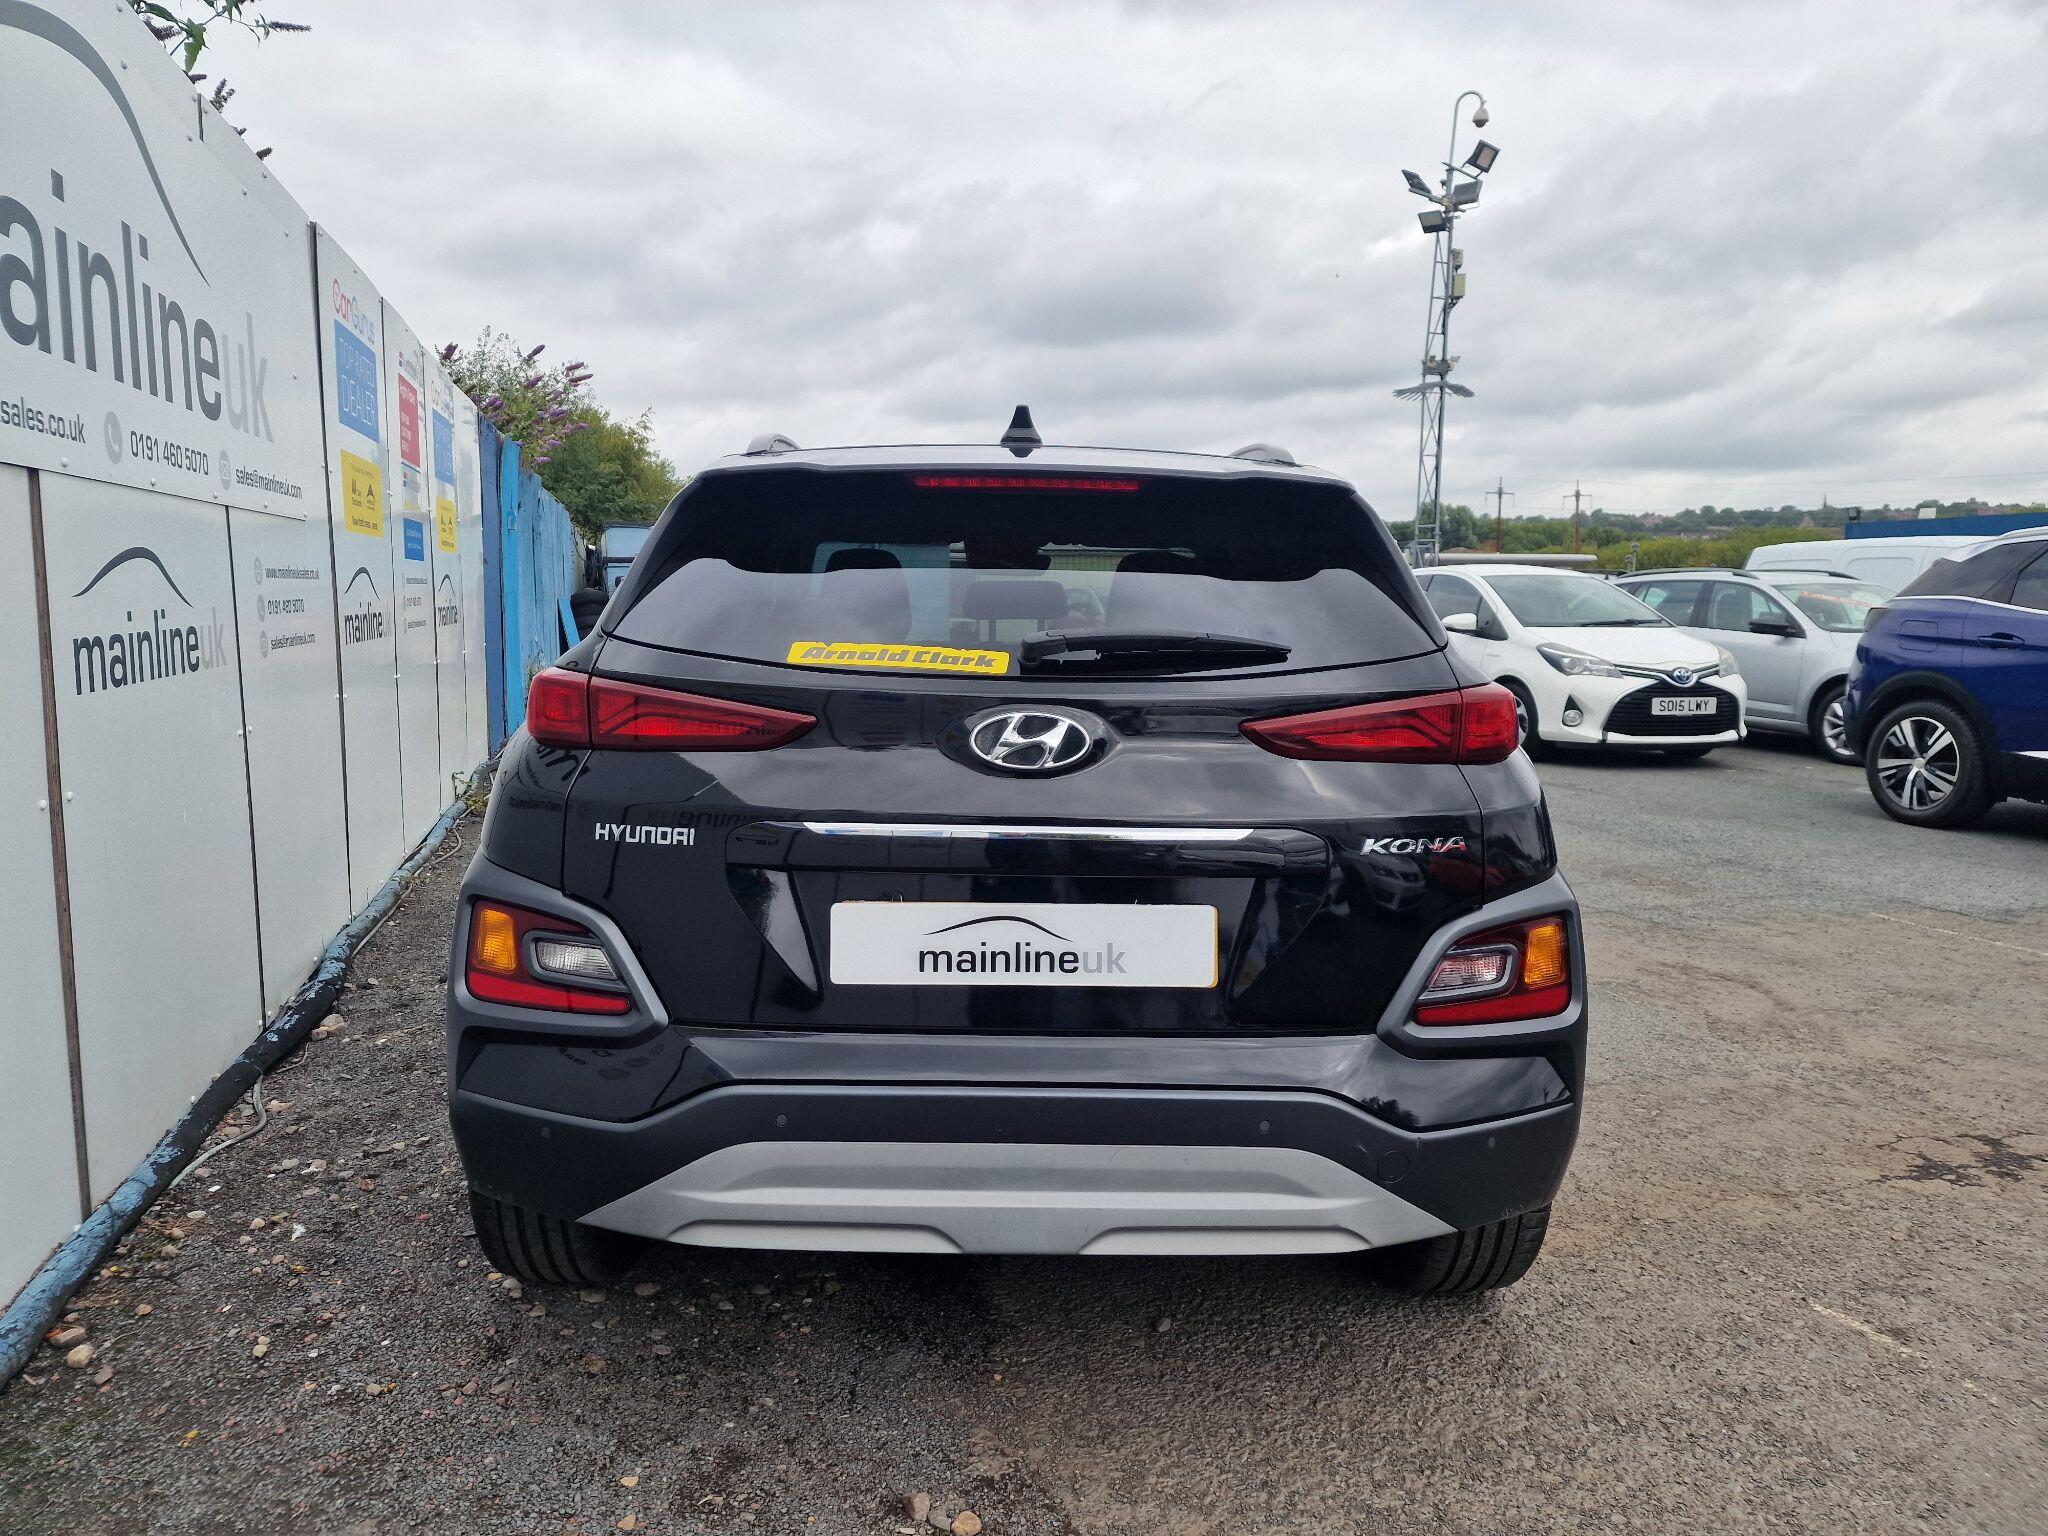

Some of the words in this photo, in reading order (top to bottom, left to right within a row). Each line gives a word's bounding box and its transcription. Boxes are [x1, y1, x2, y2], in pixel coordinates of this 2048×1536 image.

[342, 374, 376, 429] DEALER
[0, 397, 86, 444] sales.co.uk
[130, 430, 159, 463] 0191
[163, 442, 182, 469] 460
[185, 447, 209, 476] 5070
[73, 606, 228, 695] mainlineuk
[801, 646, 908, 663] Arnold
[912, 651, 997, 668] Clark
[1688, 699, 1709, 712] LWY
[595, 822, 696, 846] HYUNDAI
[1360, 836, 1467, 855] KONA
[917, 941, 1127, 974] mainlineuk
